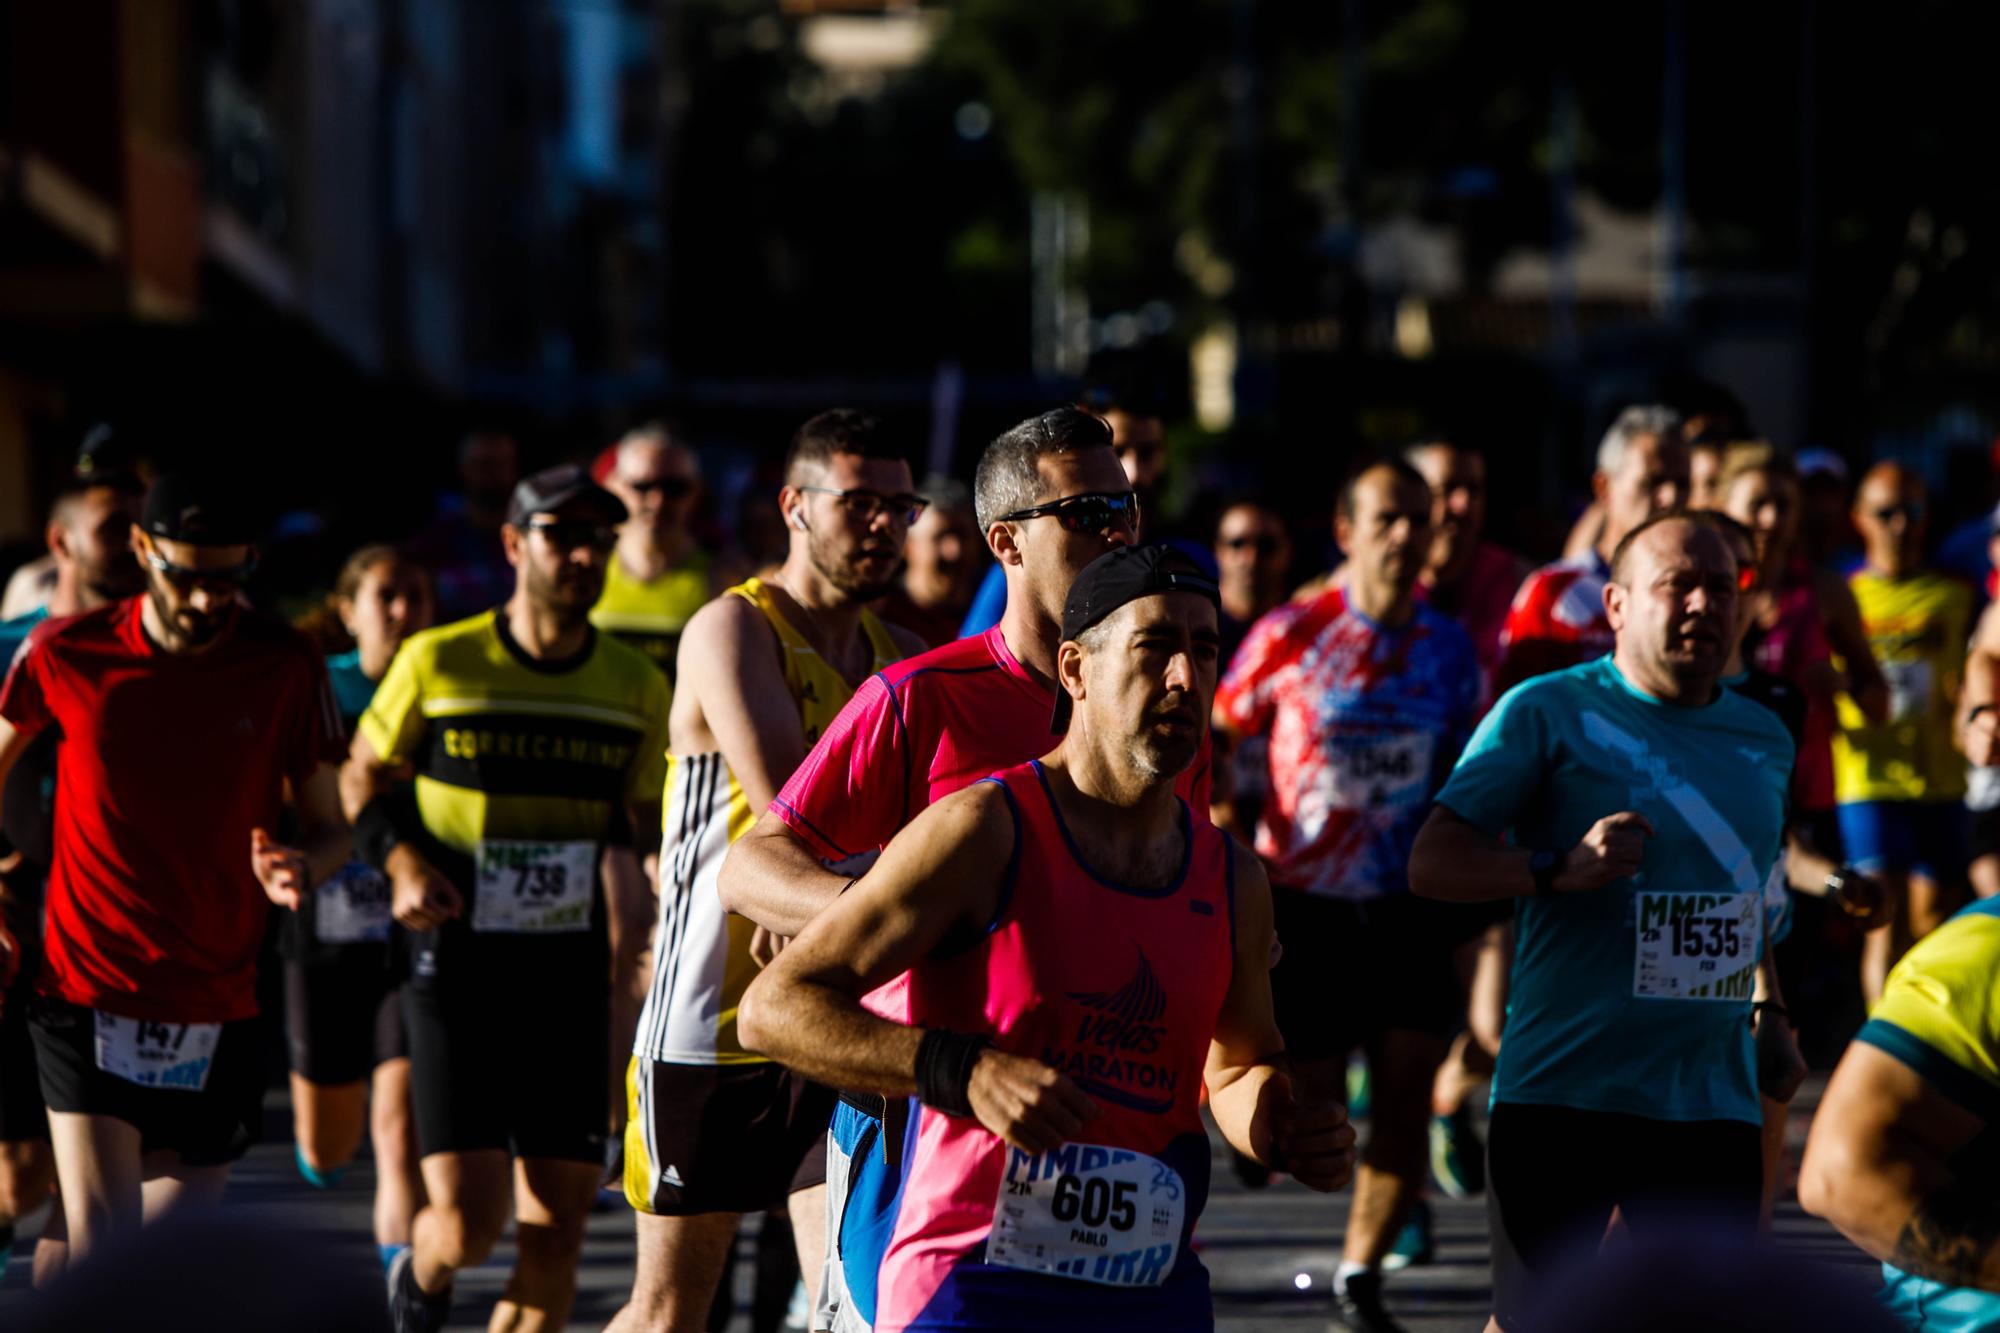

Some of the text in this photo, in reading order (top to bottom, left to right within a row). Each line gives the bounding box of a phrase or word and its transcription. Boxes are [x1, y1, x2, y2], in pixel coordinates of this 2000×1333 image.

[512, 863, 566, 896] 738
[1669, 917, 1739, 957] 1535
[1042, 1047, 1179, 1092] MARATON
[1052, 1173, 1138, 1232] 605
[1070, 1228, 1108, 1248] PABLO
